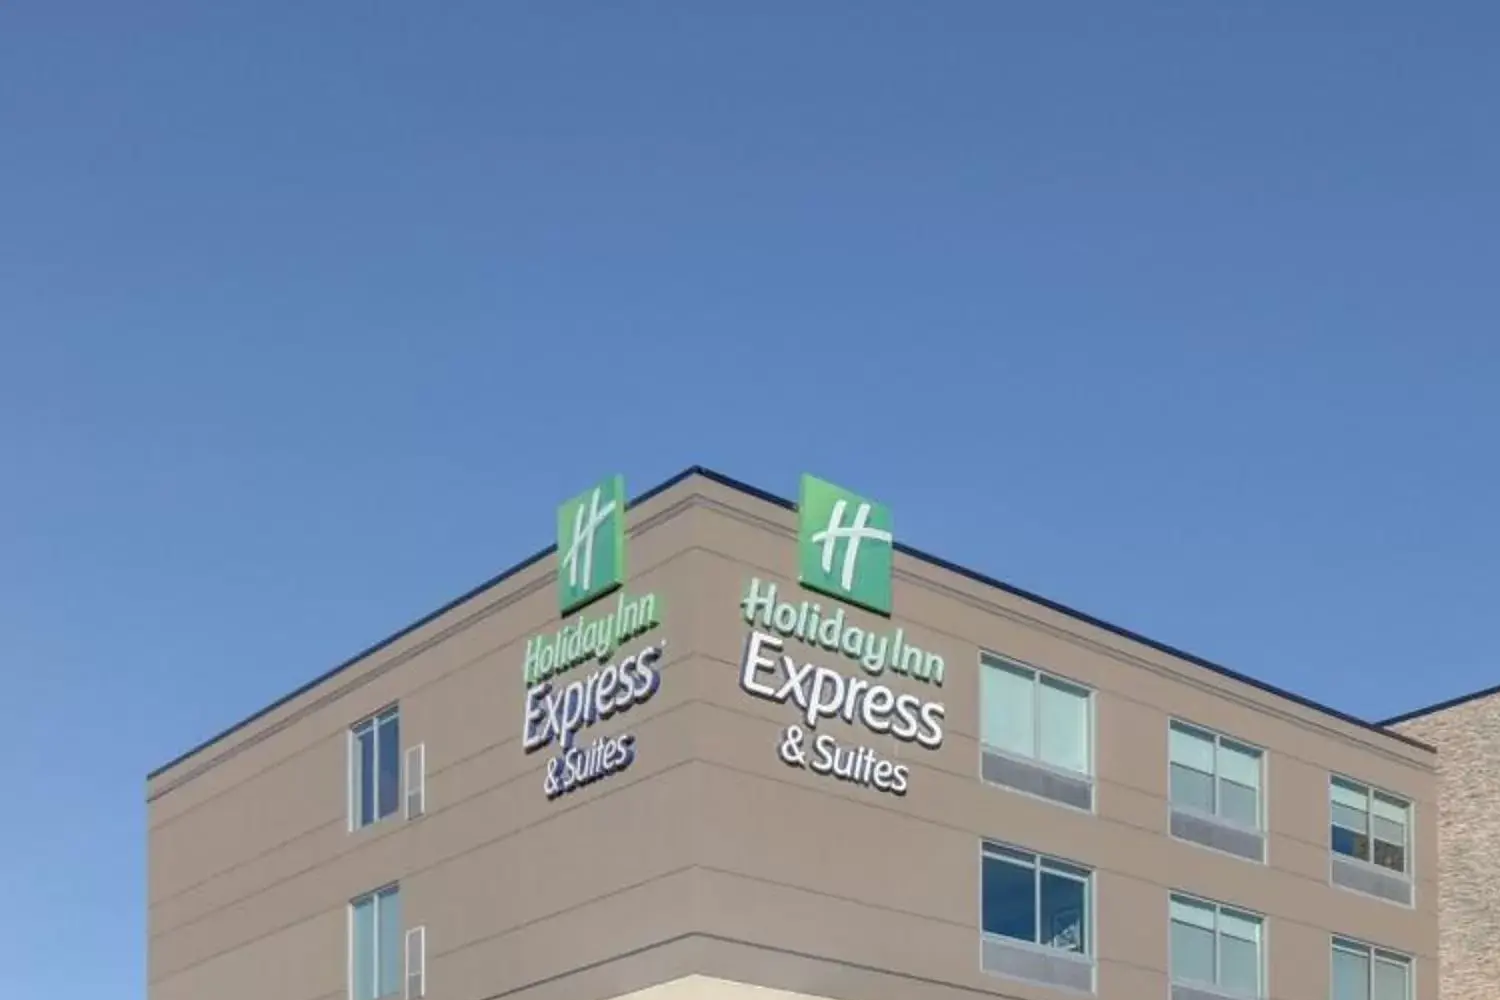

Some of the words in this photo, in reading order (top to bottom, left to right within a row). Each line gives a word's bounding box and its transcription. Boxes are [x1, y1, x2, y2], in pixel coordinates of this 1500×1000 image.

[524, 615, 615, 686] Holiday
[616, 592, 657, 640] Inn
[741, 576, 889, 674] Holiday
[889, 627, 947, 687] Inn
[522, 645, 661, 751] Express
[741, 630, 946, 749] Express
[543, 756, 561, 797] &
[561, 733, 635, 788] Suites
[779, 724, 806, 768] &
[811, 734, 910, 796] Suites
